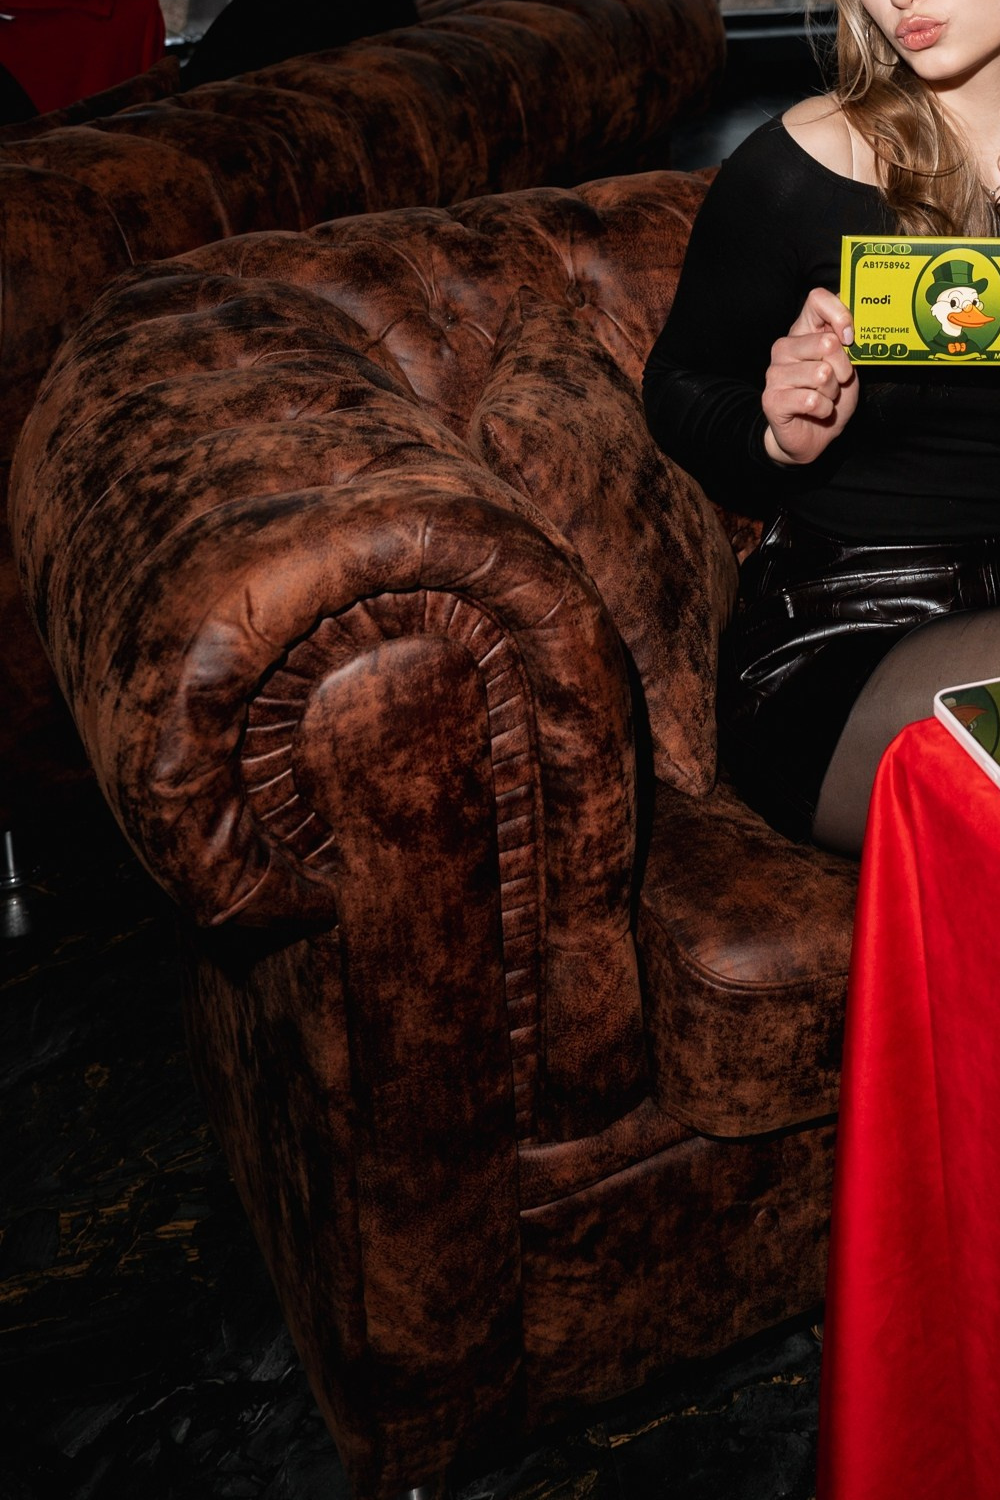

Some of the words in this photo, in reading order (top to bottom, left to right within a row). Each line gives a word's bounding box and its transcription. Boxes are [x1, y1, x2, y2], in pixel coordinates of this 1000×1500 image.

[863, 243, 912, 255] 100
[861, 294, 891, 305] modi
[860, 326, 910, 334] НАСТРОЕНИЕ
[860, 342, 910, 358] 100
